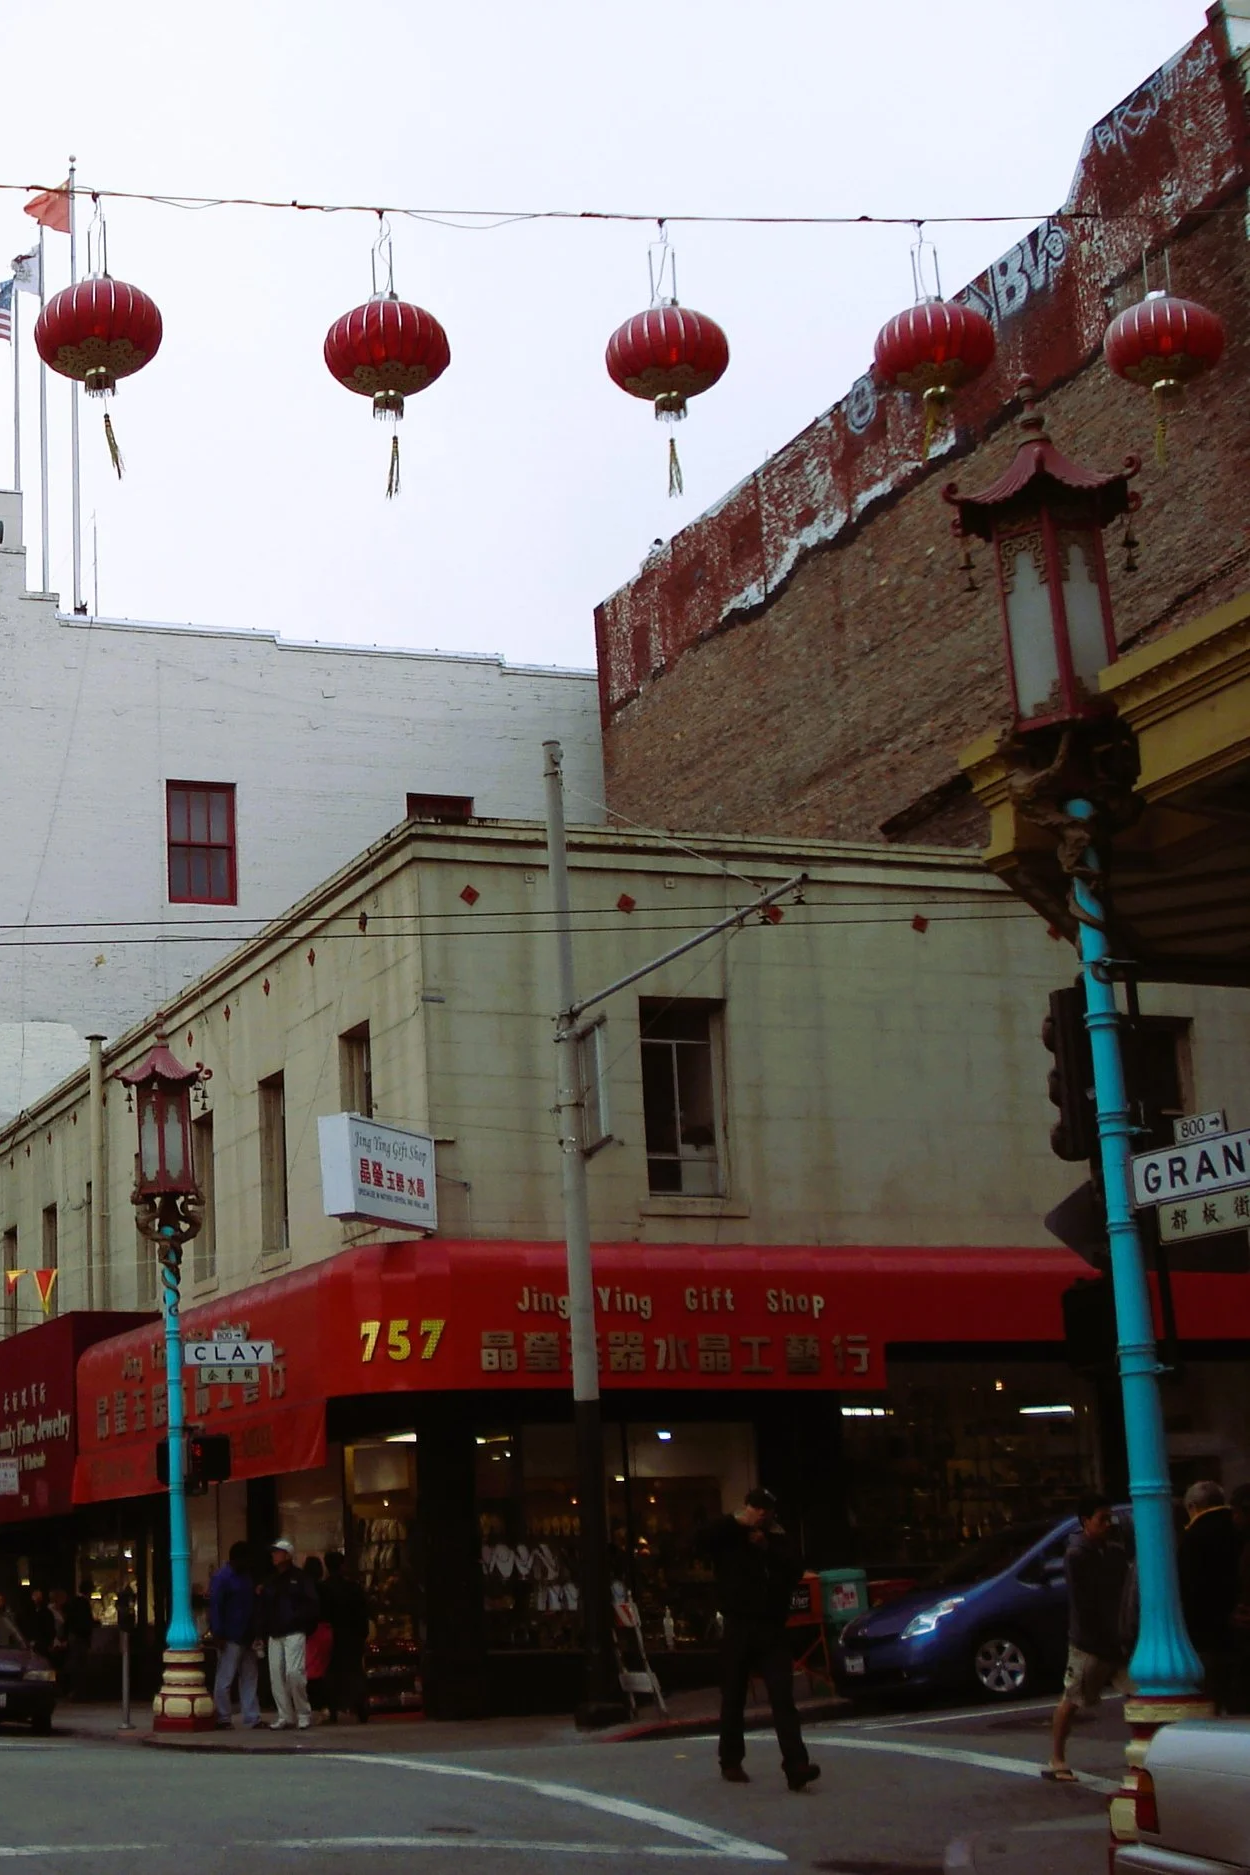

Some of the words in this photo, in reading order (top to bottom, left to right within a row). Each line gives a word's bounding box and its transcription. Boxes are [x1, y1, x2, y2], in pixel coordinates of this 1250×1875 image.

[1181, 1118, 1206, 1138] 800
[355, 1131, 371, 1152] Jing
[373, 1135, 391, 1156] Ying
[392, 1140, 408, 1162] Gift
[410, 1145, 427, 1168] Shop
[1144, 1138, 1250, 1194] GRAN
[1171, 1195, 1250, 1232] 都板街
[517, 1286, 571, 1320] Jing
[597, 1286, 652, 1320] Ying
[685, 1287, 734, 1312] Gift
[766, 1288, 825, 1318] Shop
[194, 1345, 265, 1361] CLAY
[216, 1332, 233, 1340] 800
[359, 1319, 446, 1363] 757
[37, 1408, 71, 1442] Jewelry
